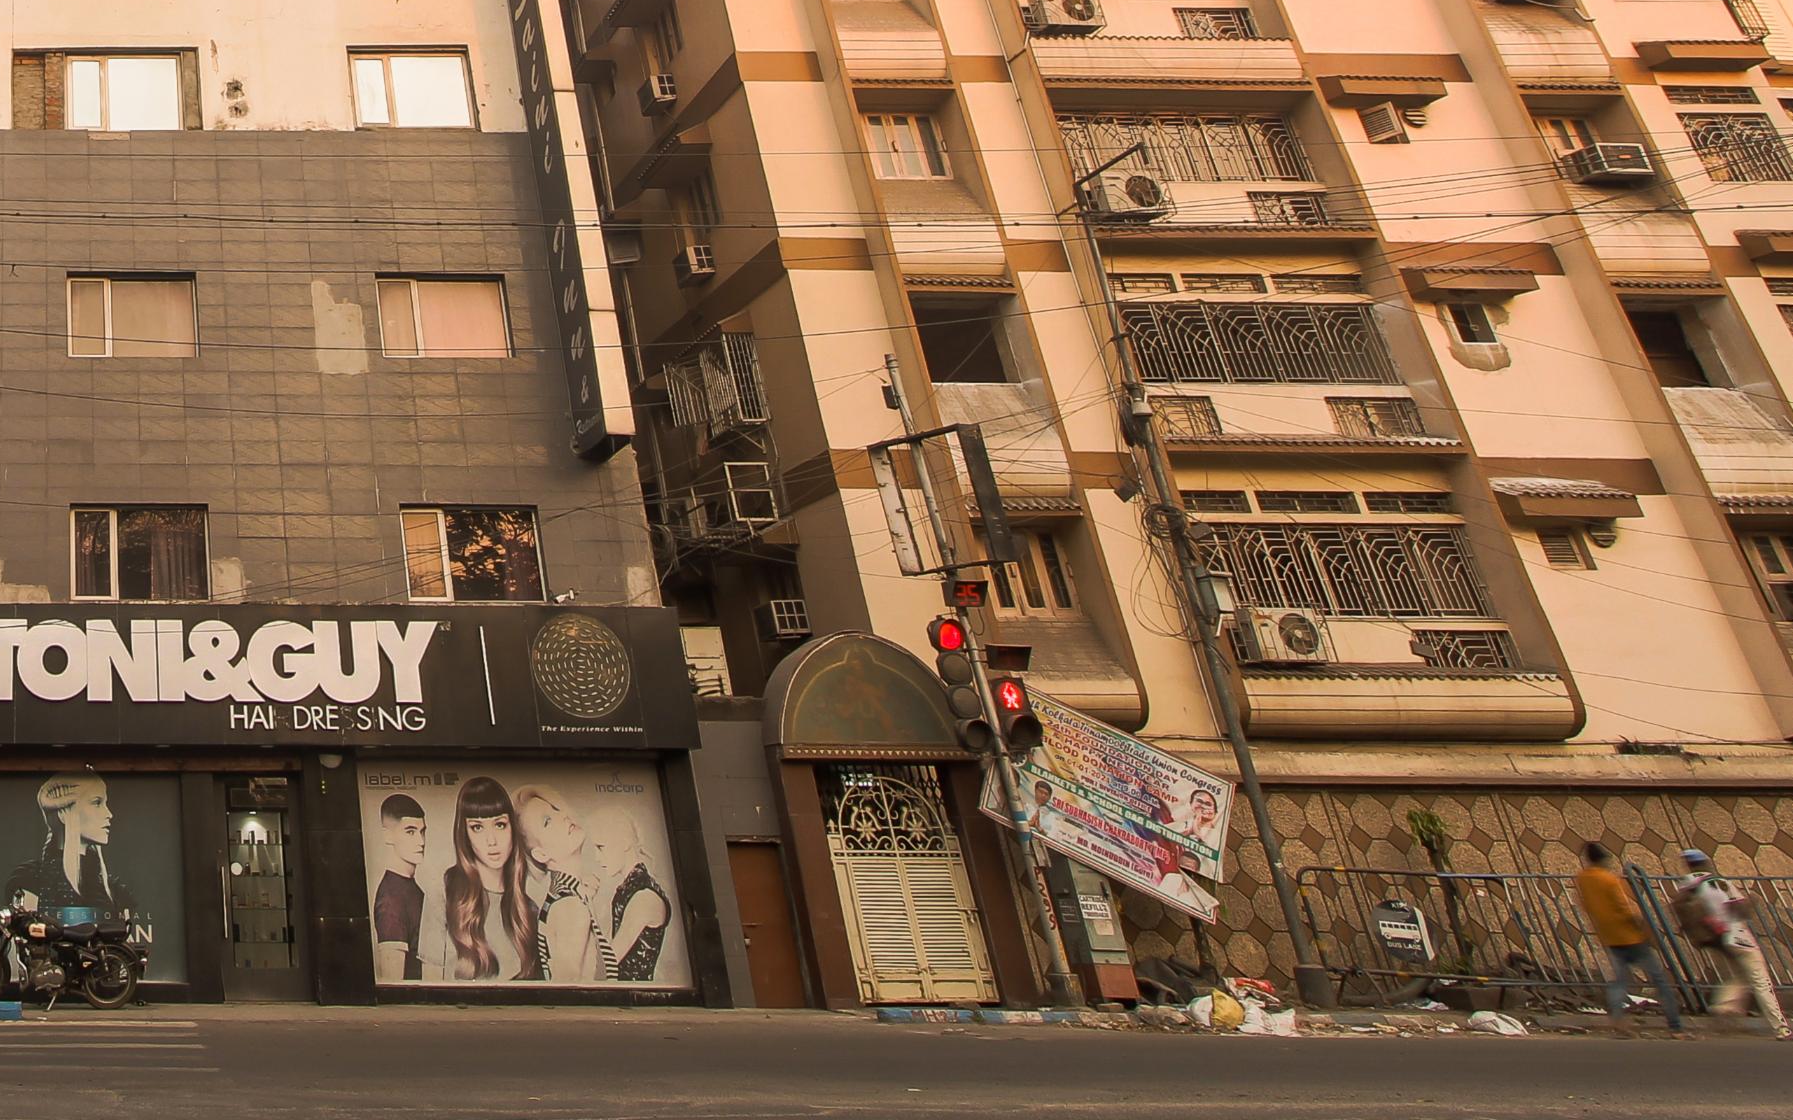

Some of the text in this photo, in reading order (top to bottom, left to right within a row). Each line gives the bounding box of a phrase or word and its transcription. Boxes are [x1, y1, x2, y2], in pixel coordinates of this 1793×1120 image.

[560, 725, 610, 733] Experience
[1041, 704, 1078, 729] Kolkata
[1151, 755, 1178, 775] Union
[1179, 767, 1222, 796] Congress
[1045, 718, 1071, 735] 24th
[1074, 732, 1152, 773] FOUNDATION
[1155, 770, 1178, 785] DAY
[1063, 736, 1104, 760] HAPPY
[1107, 756, 1136, 775] NEW
[1137, 771, 1169, 791] YEAR
[1081, 753, 1143, 788] DONATION
[1145, 783, 1178, 805] CAMP
